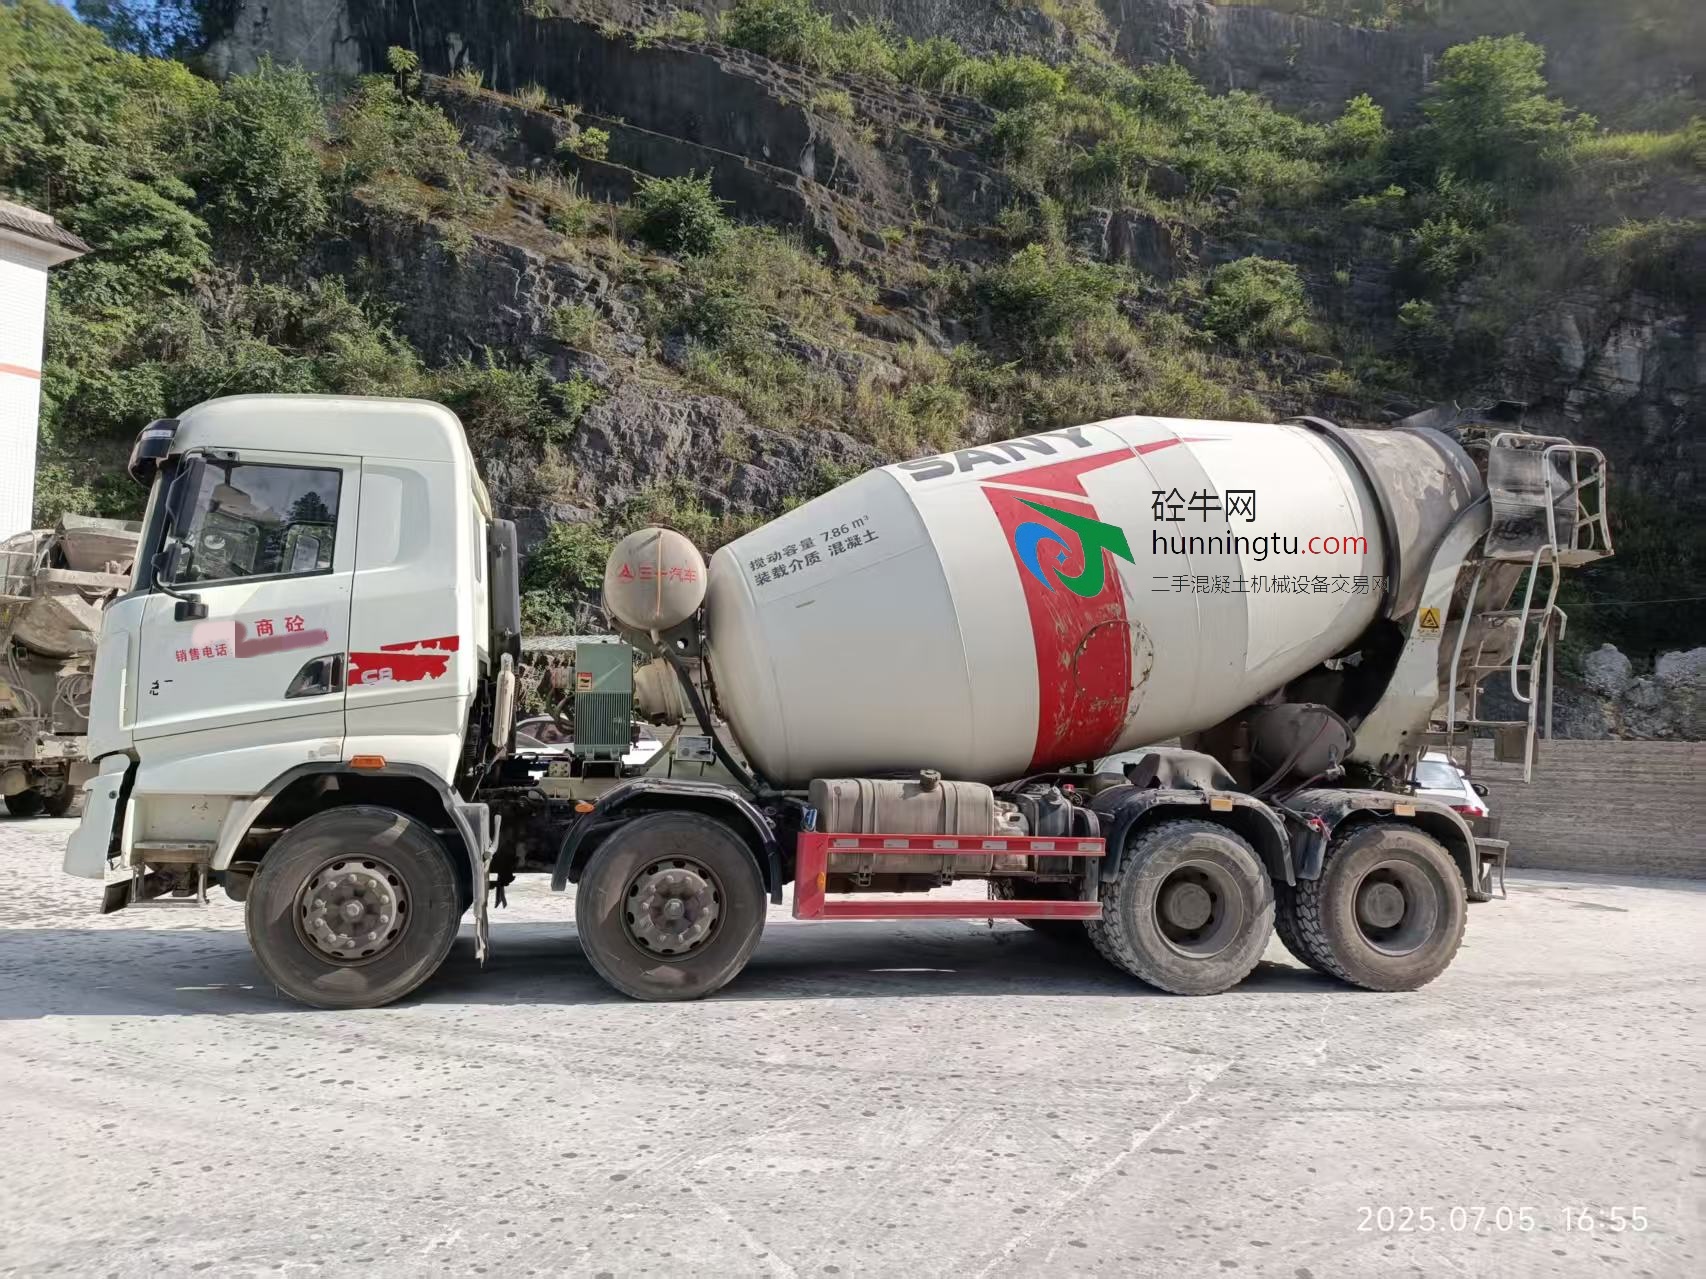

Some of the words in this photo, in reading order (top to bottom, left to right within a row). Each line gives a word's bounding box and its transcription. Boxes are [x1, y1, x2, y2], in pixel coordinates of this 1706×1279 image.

[897, 427, 1093, 482] SANY
[749, 537, 817, 571] 搅动容量
[820, 523, 851, 542] 7.86
[754, 550, 822, 587] 装载介质
[828, 529, 880, 557] 混凝土
[639, 566, 697, 584] 三一汽车
[175, 643, 228, 662] 销售电话
